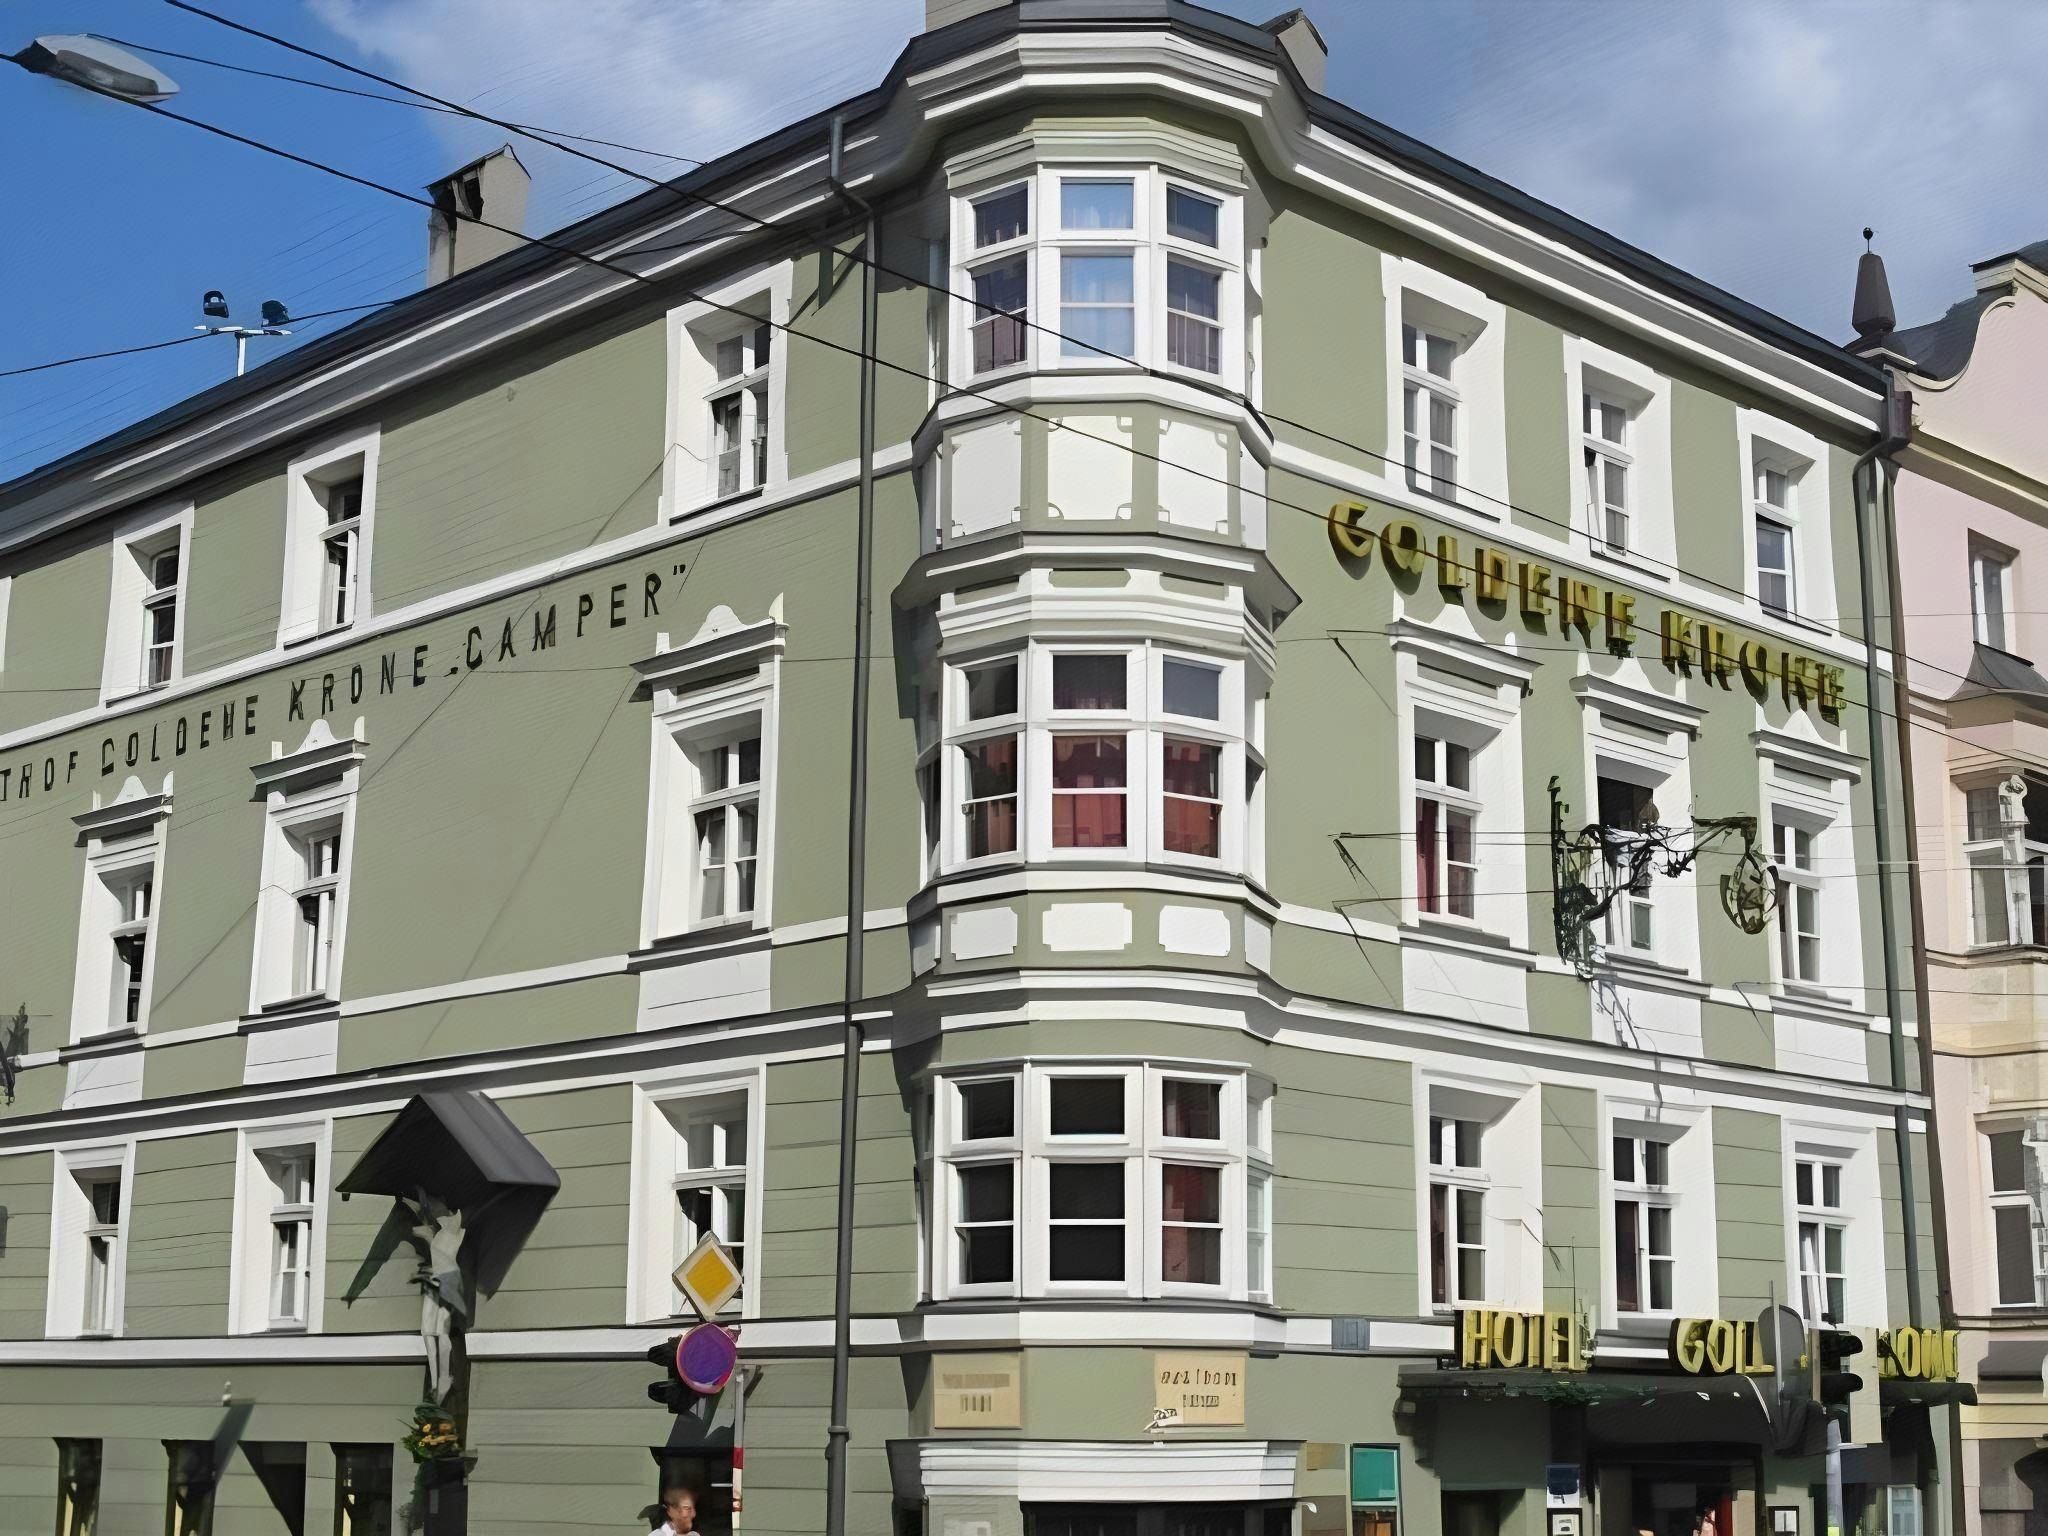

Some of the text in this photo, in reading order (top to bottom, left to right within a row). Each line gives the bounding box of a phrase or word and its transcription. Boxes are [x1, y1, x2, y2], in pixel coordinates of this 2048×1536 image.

[1328, 501, 1637, 650] GOLDENE
[288, 645, 428, 722] KRONE
[1456, 1309, 1589, 1373] HOTEL
